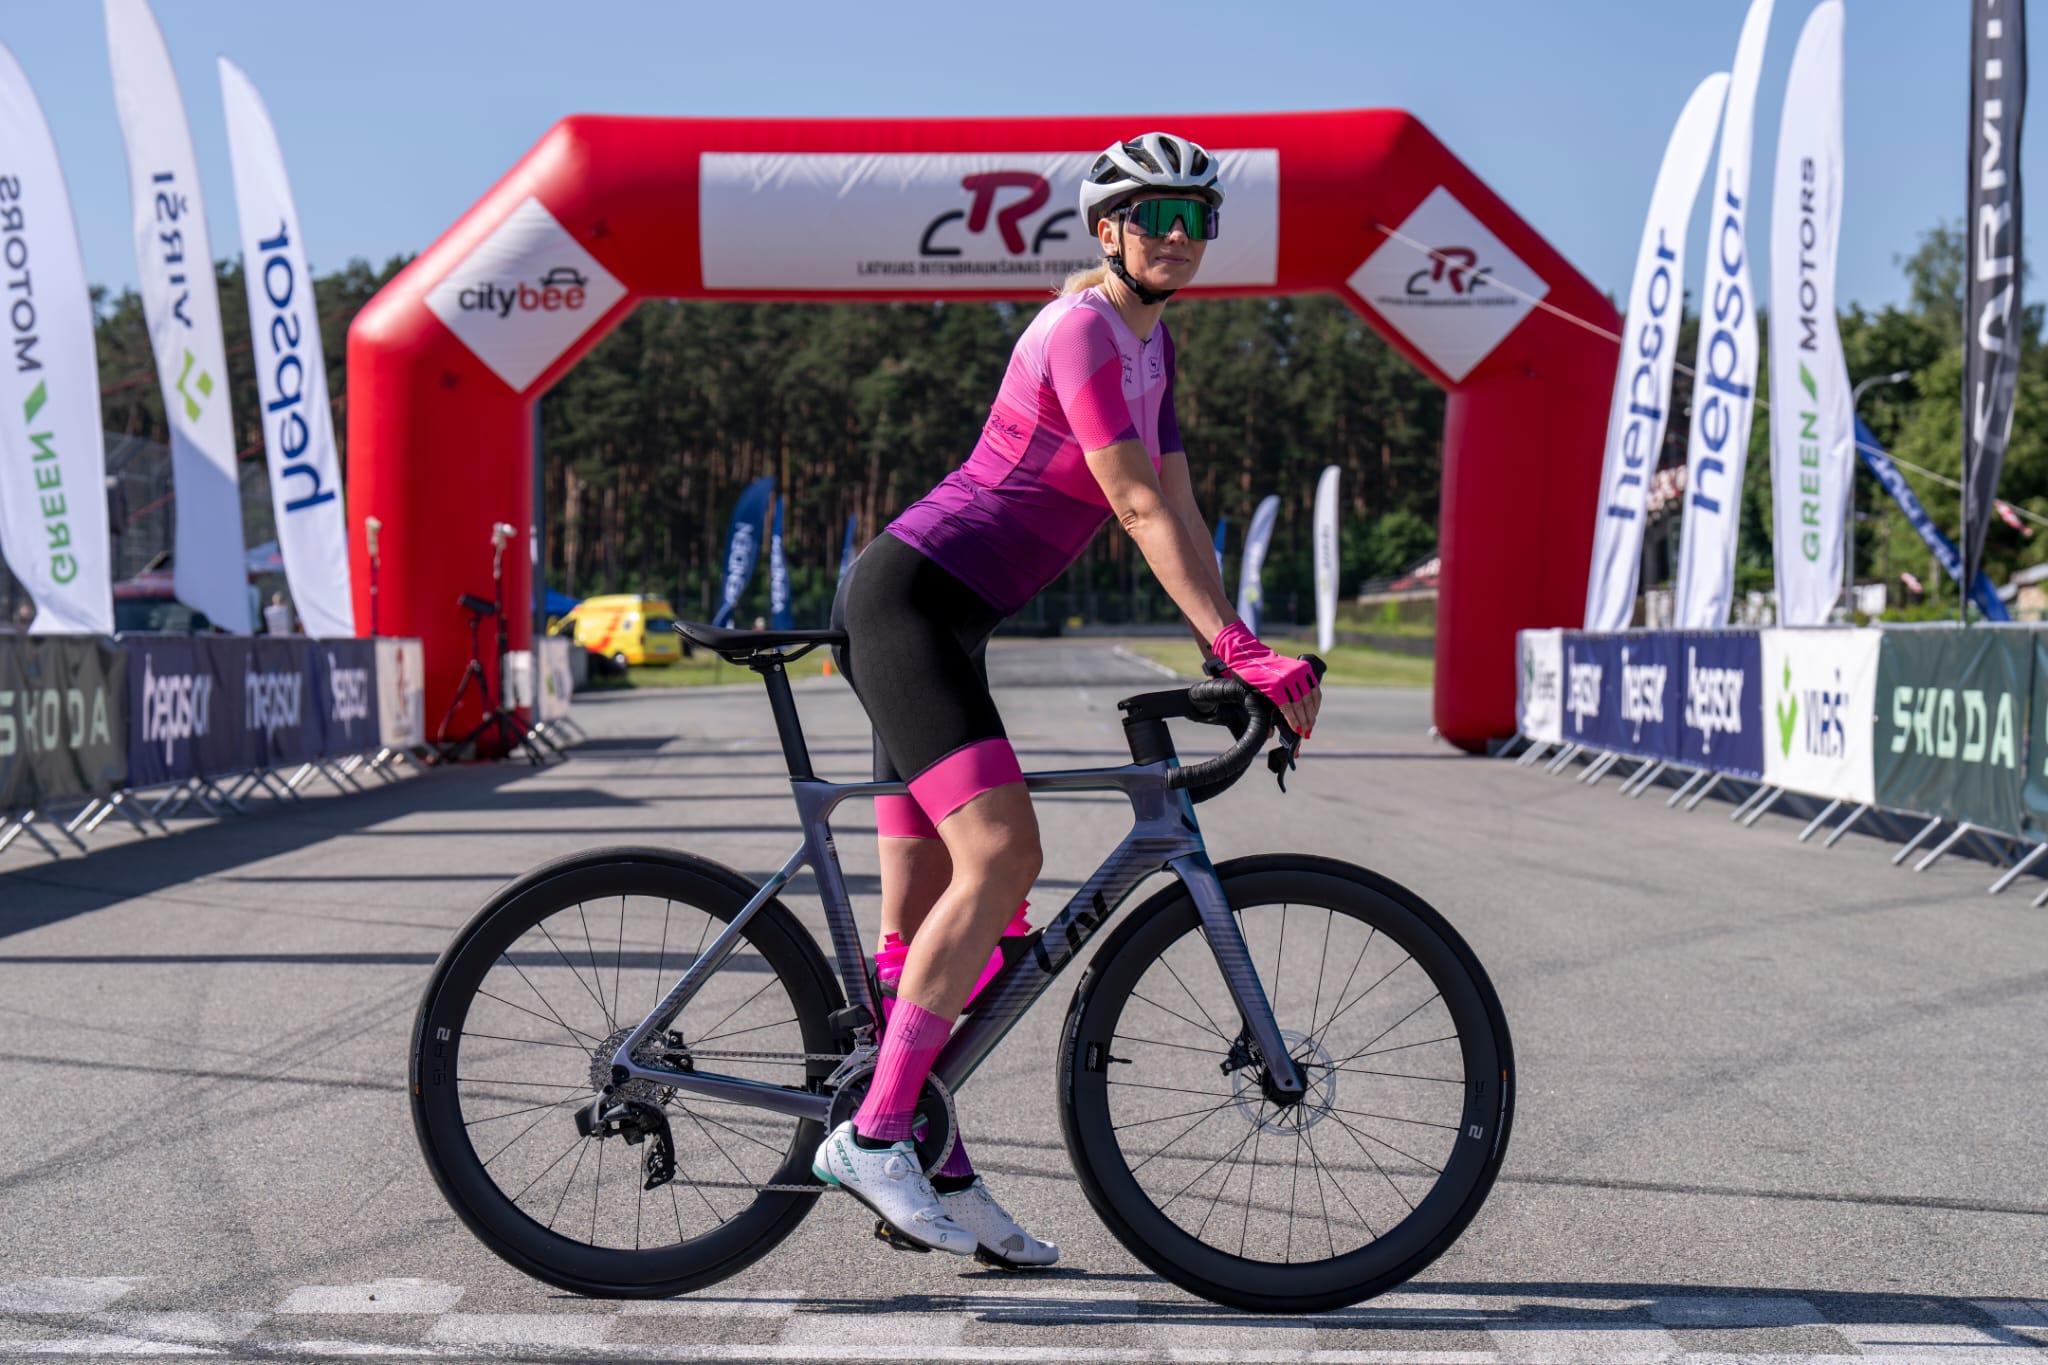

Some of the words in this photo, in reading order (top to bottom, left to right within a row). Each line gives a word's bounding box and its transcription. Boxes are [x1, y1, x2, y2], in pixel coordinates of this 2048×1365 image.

[1799, 157, 1819, 353] MOTORS
[459, 282, 587, 319] citybee
[1691, 168, 1750, 515] hepsor
[1800, 411, 1821, 563] GREEN
[436, 1026, 452, 1041] 2
[1468, 1124, 1484, 1140] 2
[833, 1138, 862, 1184] SCOTT
